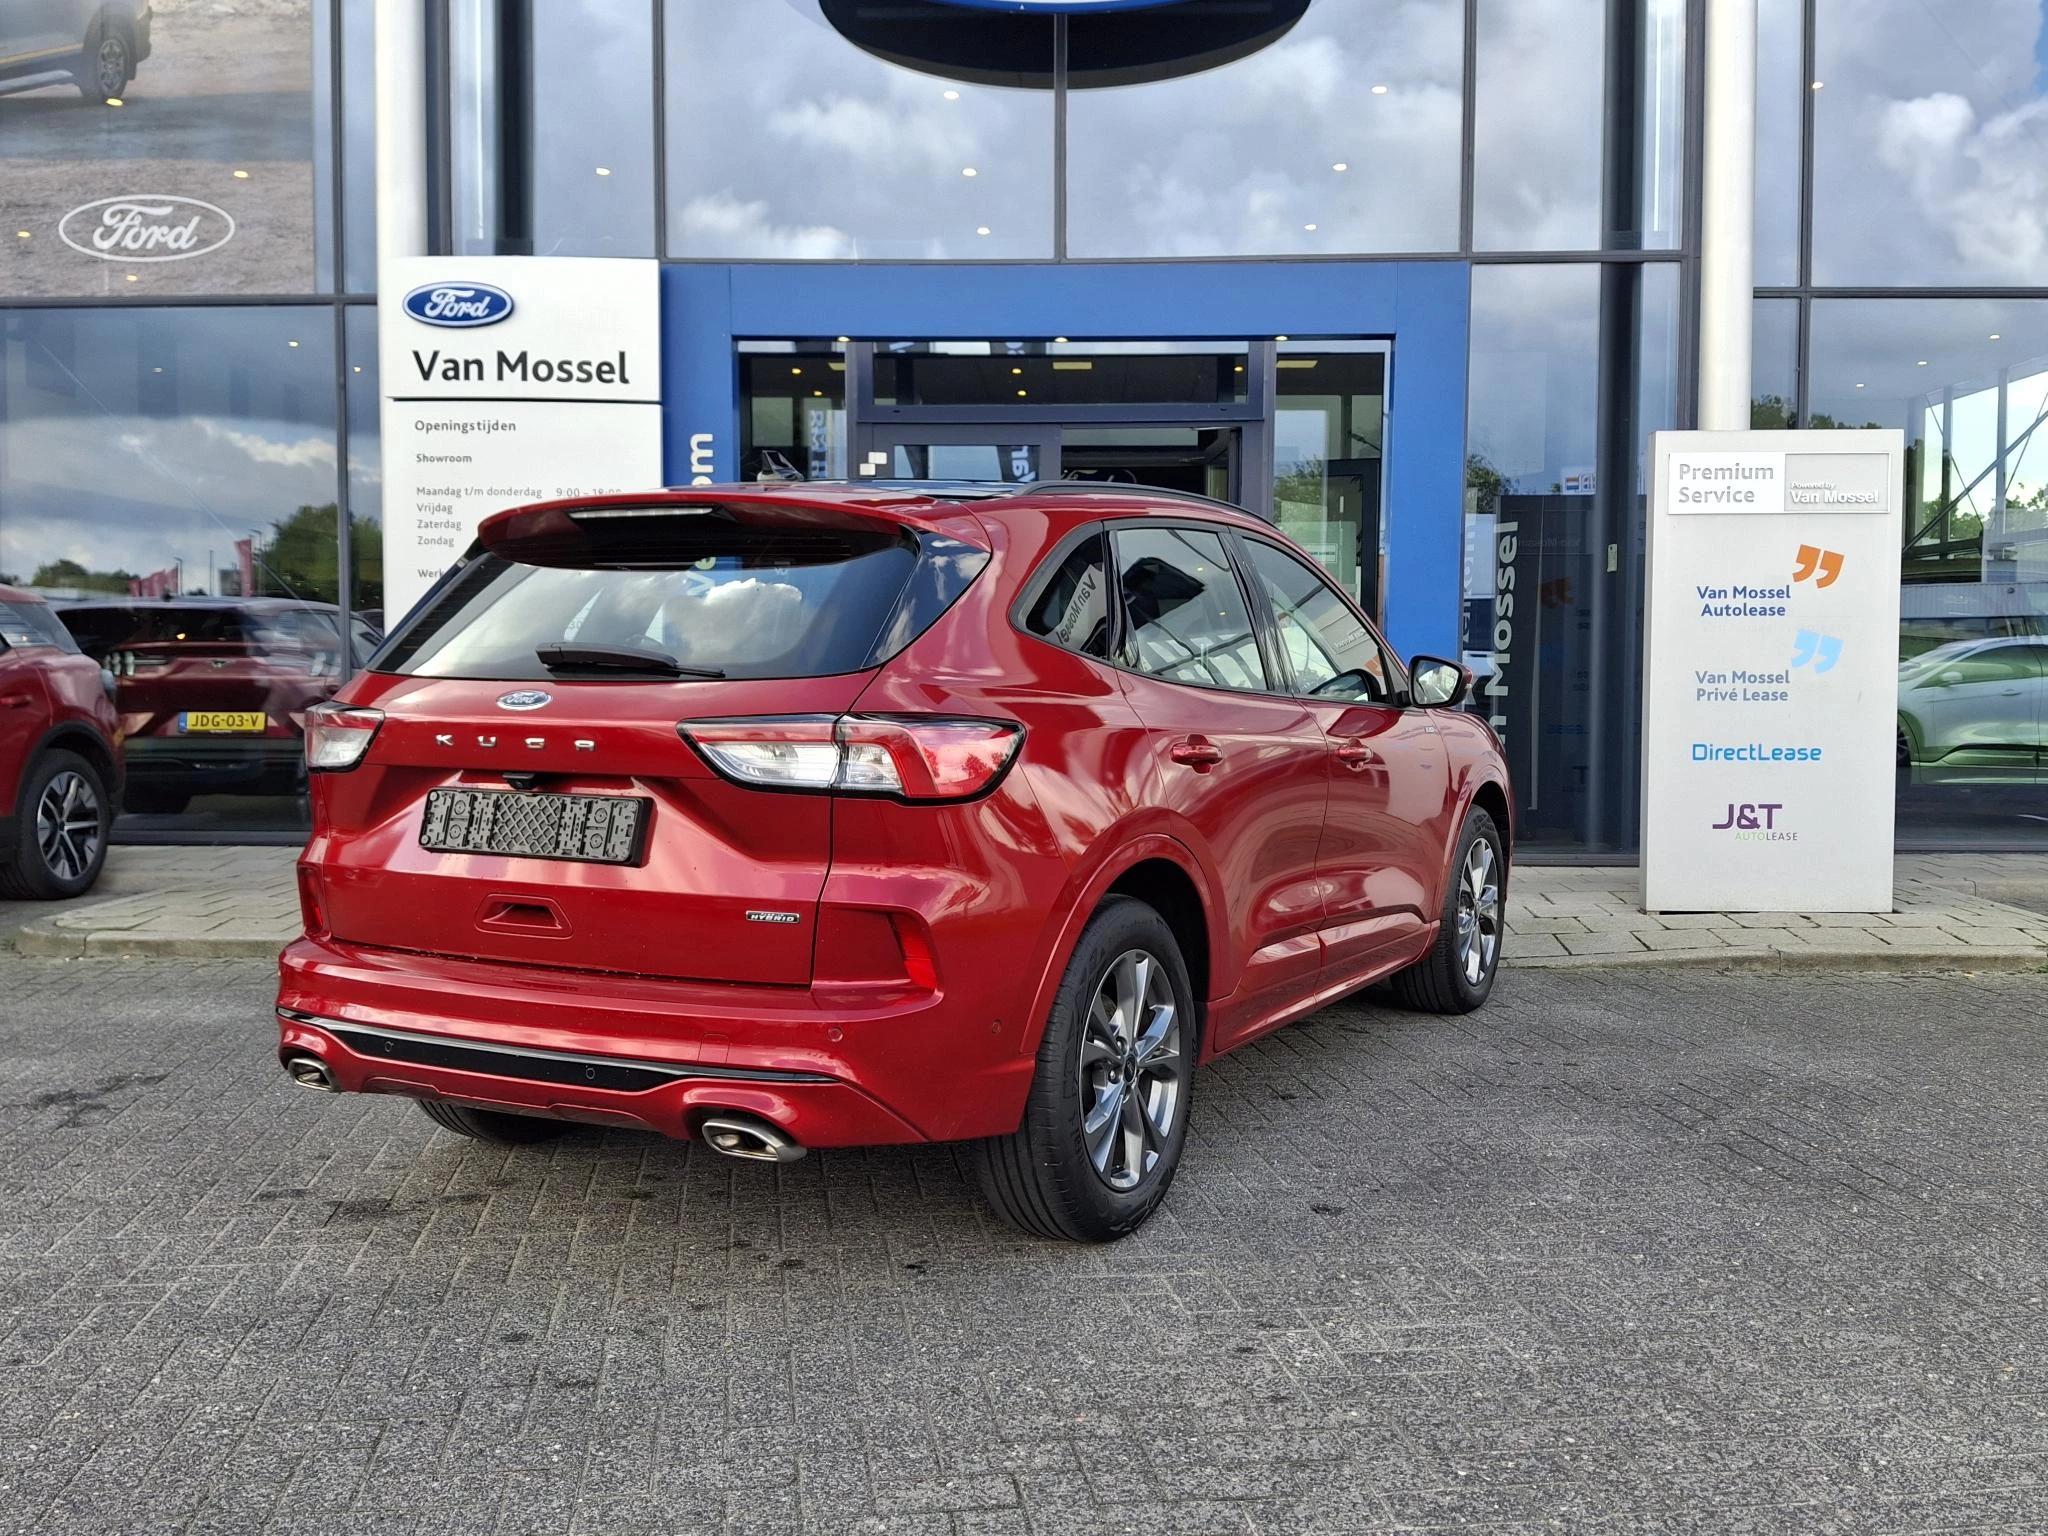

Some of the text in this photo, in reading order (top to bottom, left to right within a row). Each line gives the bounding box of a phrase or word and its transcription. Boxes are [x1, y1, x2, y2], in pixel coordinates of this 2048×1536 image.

[93, 203, 200, 250] Ford
[424, 288, 491, 317] Ford
[412, 350, 630, 385] Van Mossel
[414, 419, 517, 434] Openingstijden
[416, 452, 473, 463] Showroom
[1679, 462, 1774, 480] Premium
[416, 486, 462, 499] Maandag
[464, 486, 484, 498] t/m
[486, 486, 543, 500] donderdag
[1678, 486, 1756, 504] Service
[1791, 488, 1880, 504] Van Mossel
[416, 502, 454, 514] Vrijdag
[416, 518, 462, 532] Zaterdag
[416, 535, 455, 548] Zondag
[1696, 585, 1791, 600] Van Mossel
[1484, 520, 1519, 697] Mossel
[1700, 603, 1786, 617] Autolease
[1695, 669, 1790, 684] Van Mossel
[1696, 687, 1789, 702] Privé Lease
[191, 714, 259, 728] JDG-03-V
[1692, 743, 1822, 761] DirectLease
[1712, 803, 1783, 830] J&T
[1735, 832, 1798, 841] AUTOLEASE
